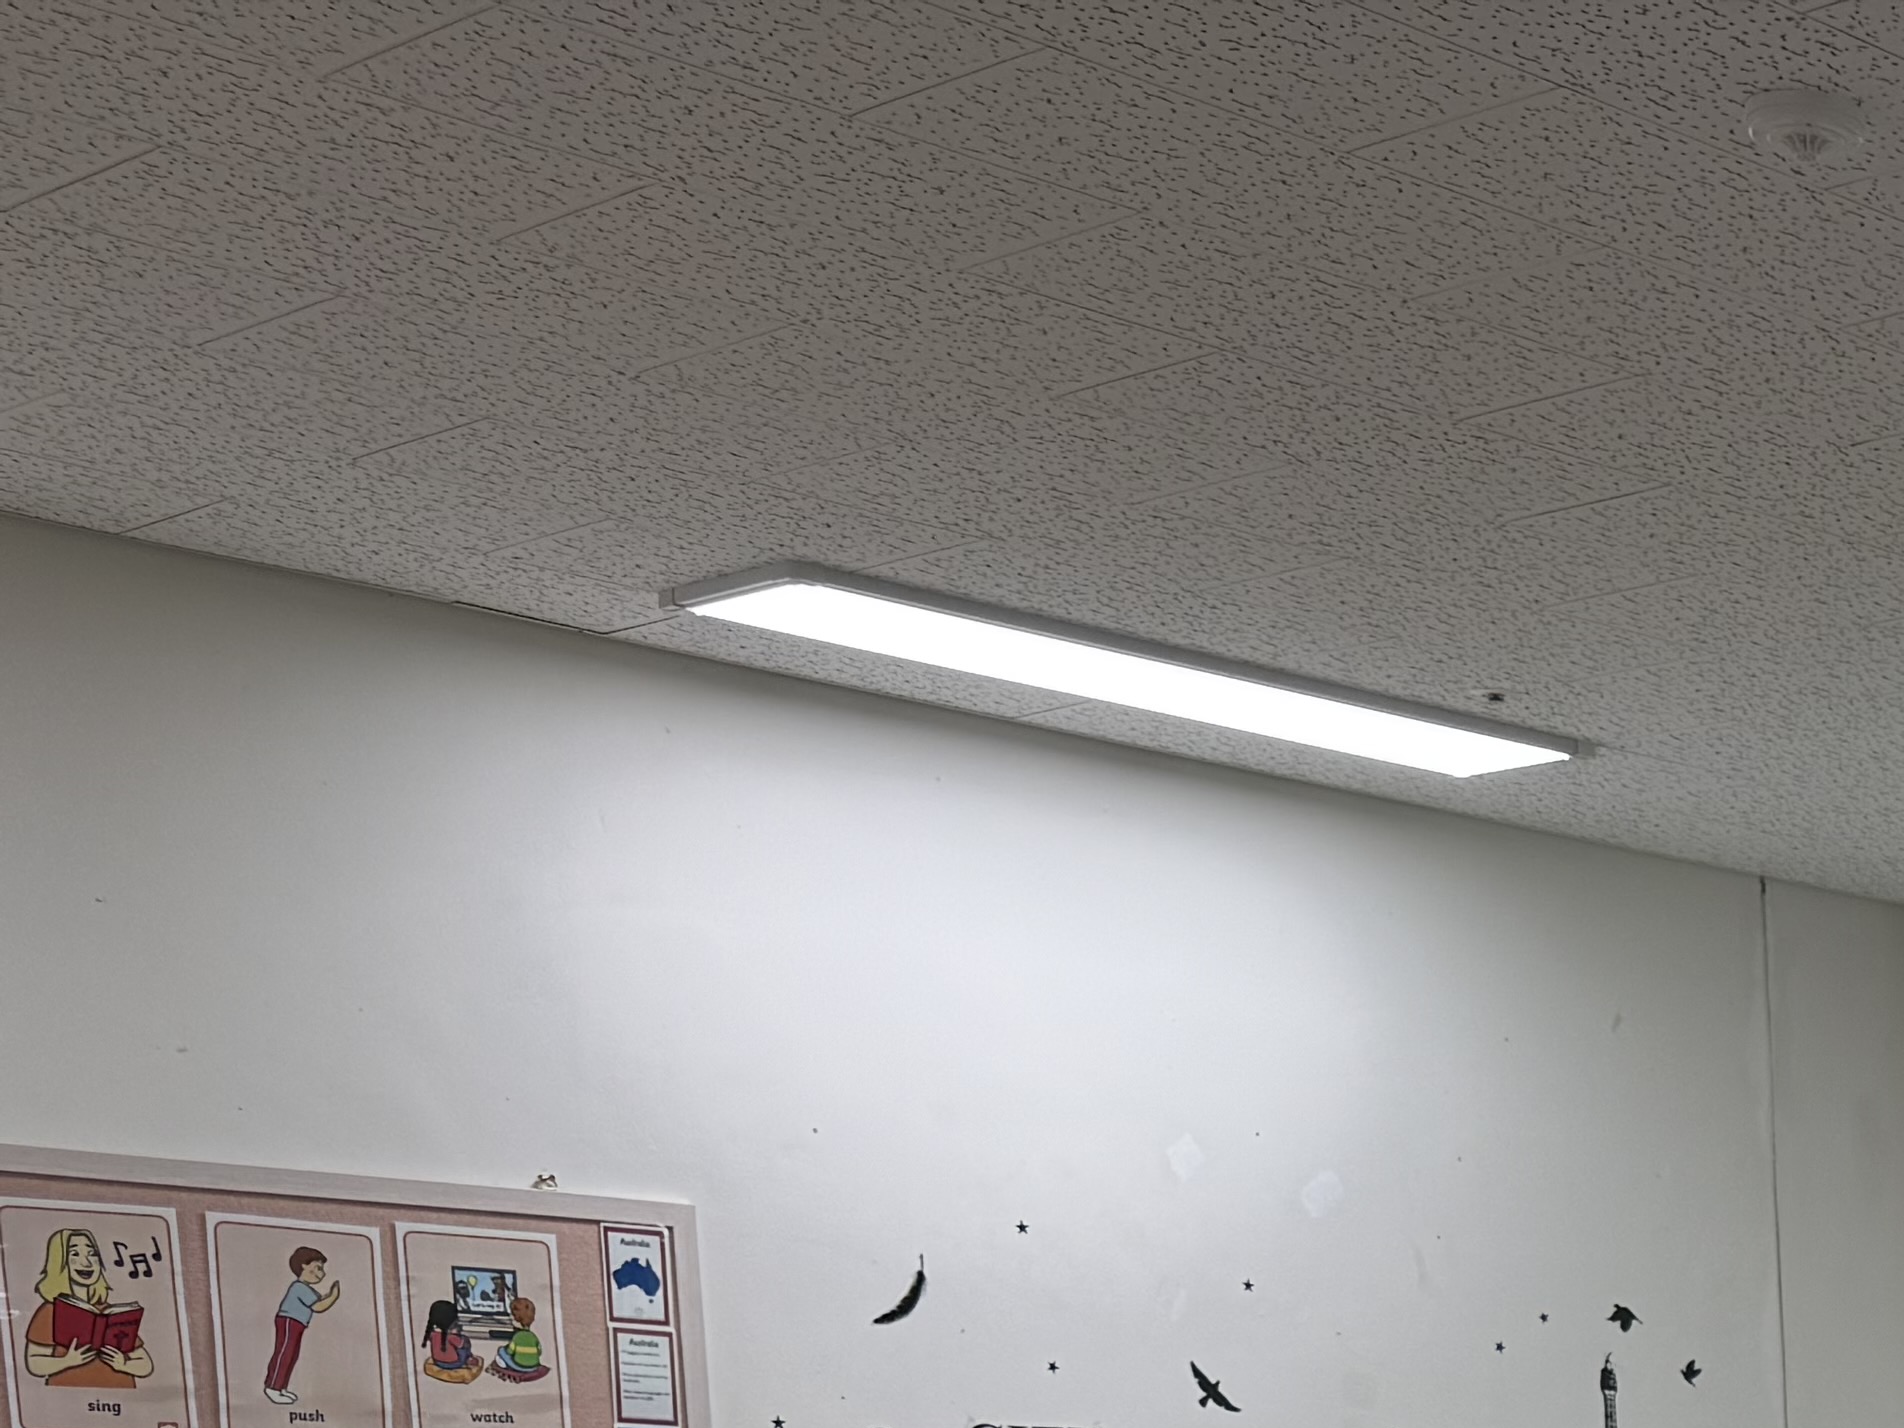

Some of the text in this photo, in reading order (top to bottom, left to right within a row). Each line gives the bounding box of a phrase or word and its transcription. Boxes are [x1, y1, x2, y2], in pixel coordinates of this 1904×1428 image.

[87, 1399, 122, 1416] sing
[289, 1409, 325, 1424] push
[470, 1411, 514, 1424] watch
